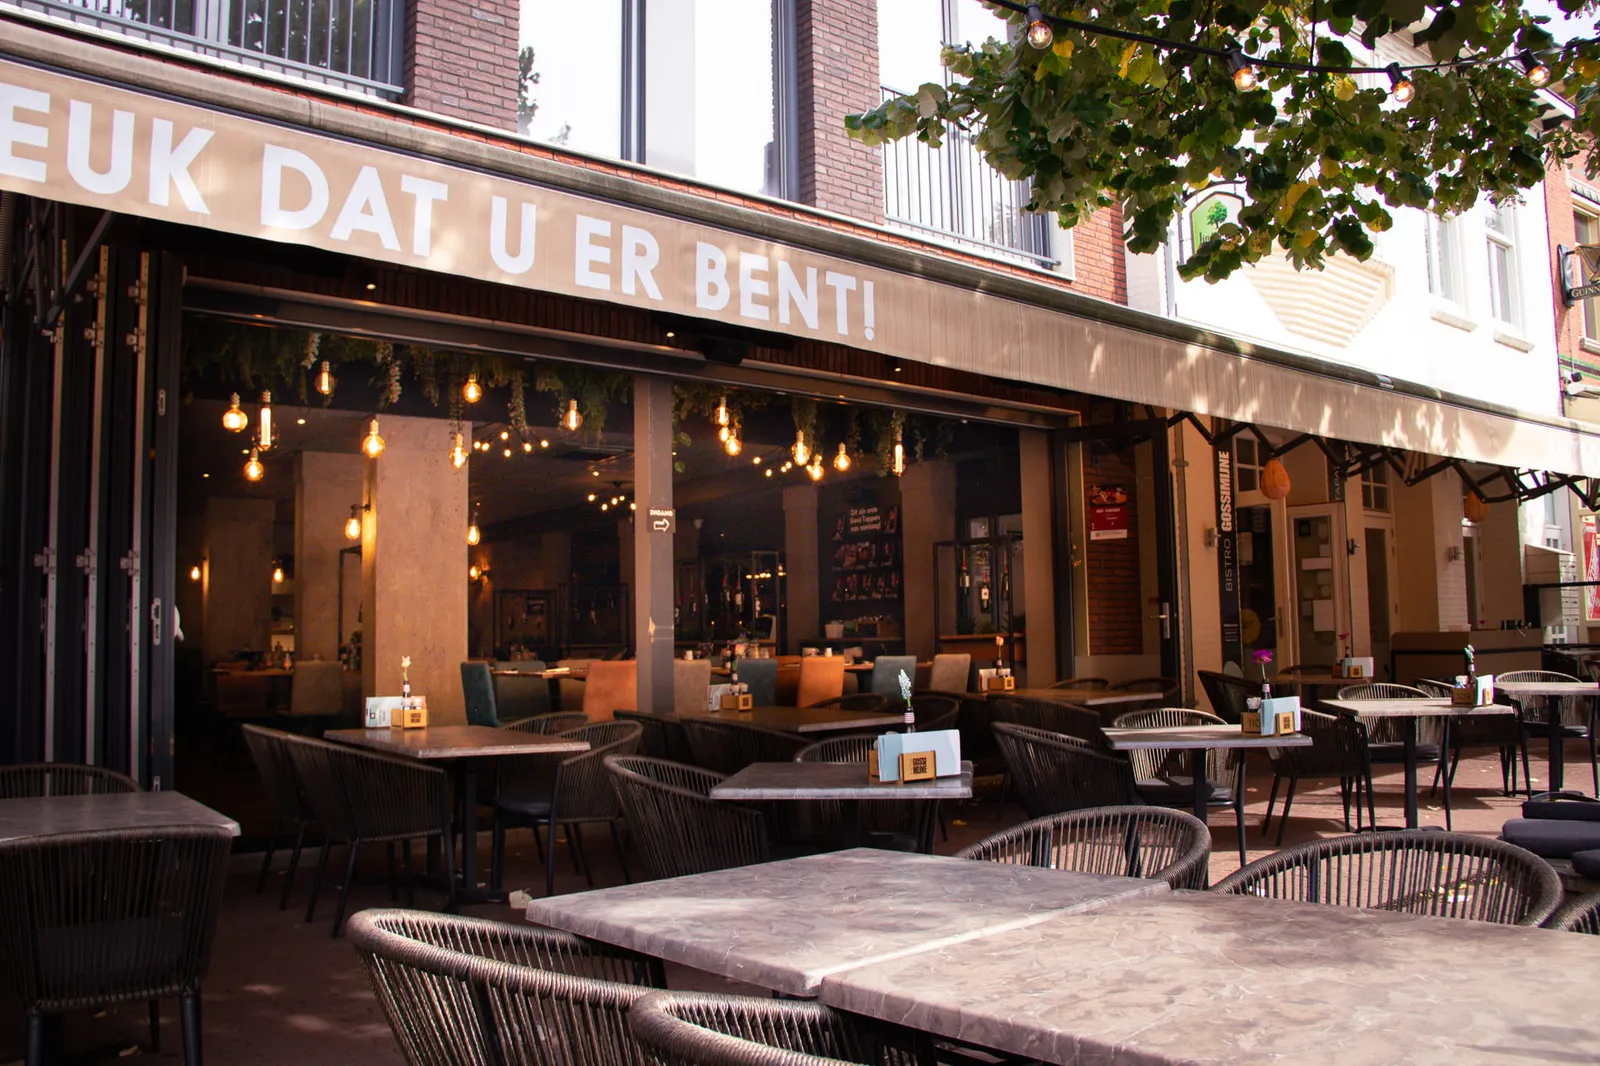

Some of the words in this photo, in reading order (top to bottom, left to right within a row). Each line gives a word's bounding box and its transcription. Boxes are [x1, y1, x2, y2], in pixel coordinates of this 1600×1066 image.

[260, 143, 448, 258] DAT
[490, 195, 537, 275] U
[575, 214, 663, 300] ER
[696, 241, 875, 341] BENT!
[1223, 538, 1233, 591] BISTRO
